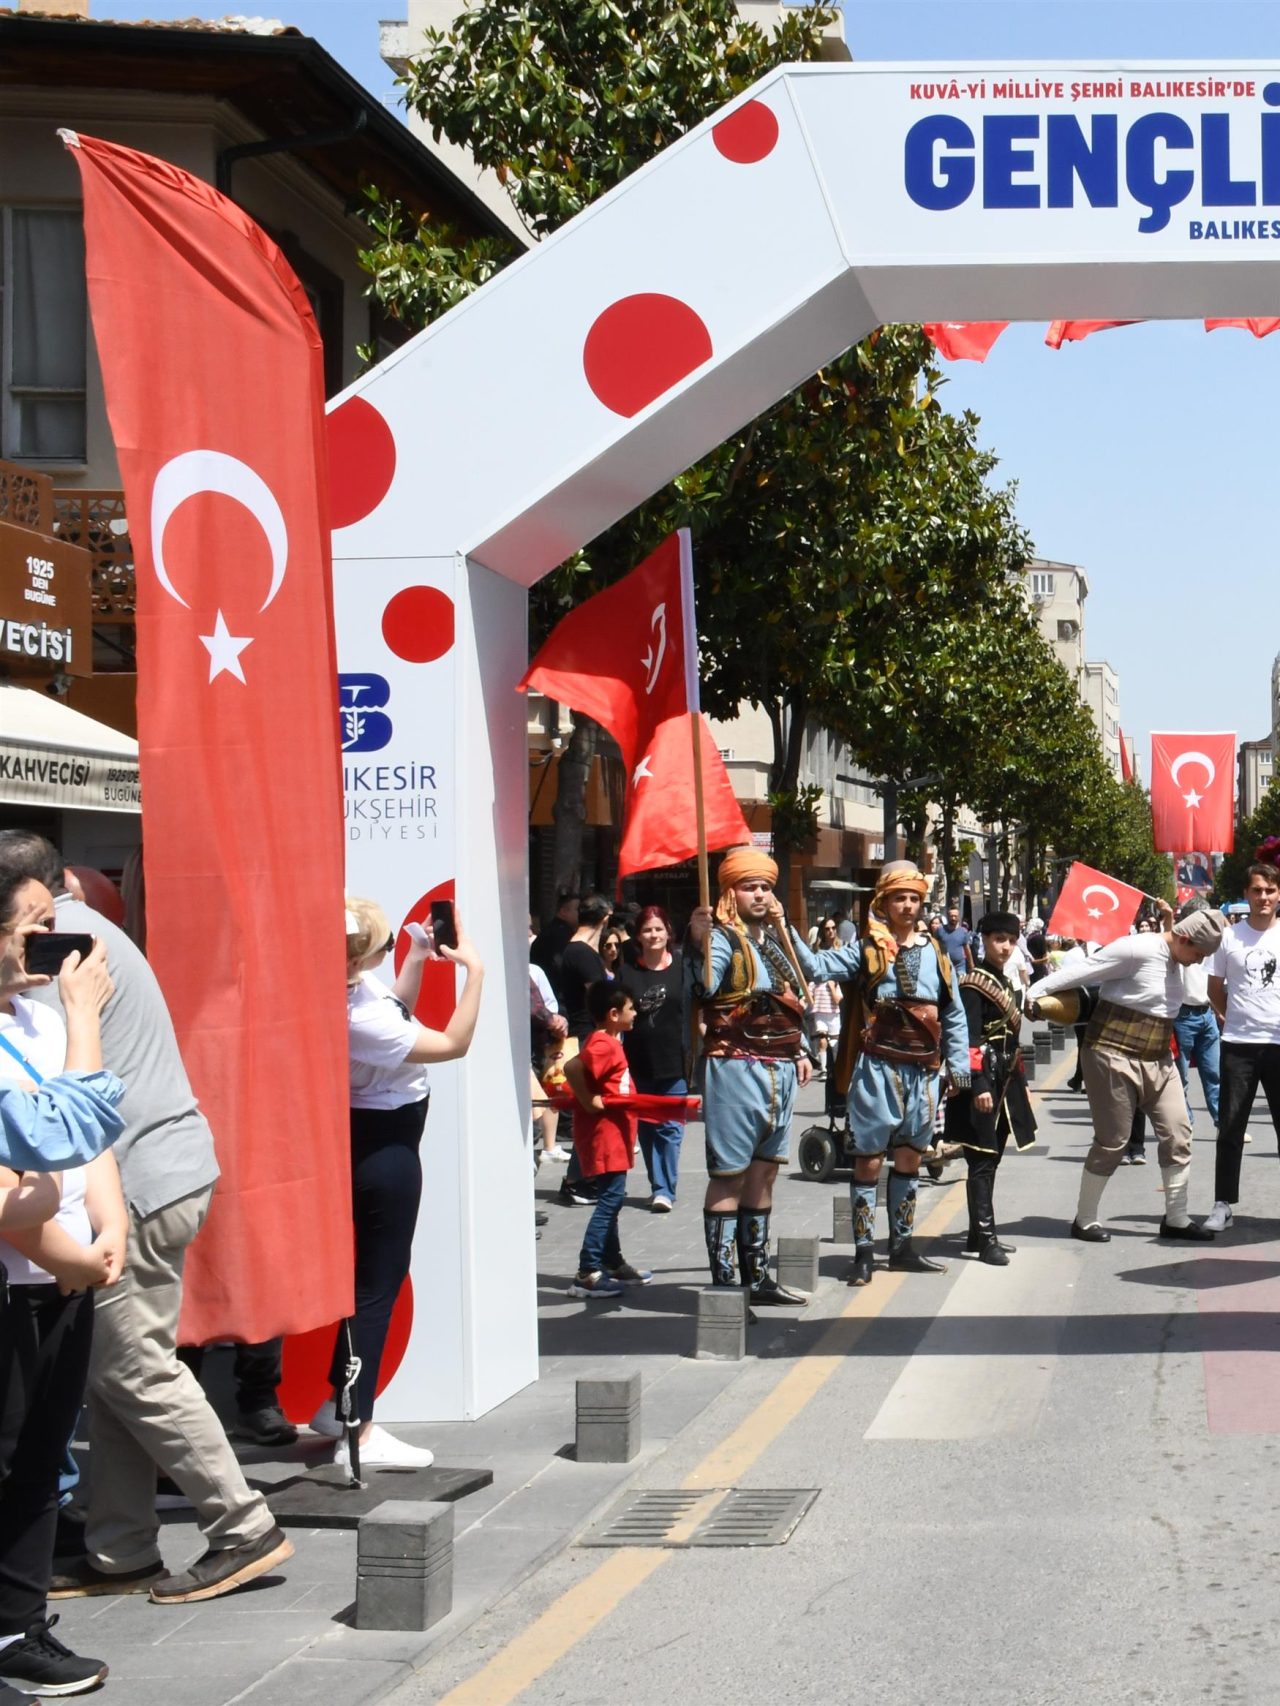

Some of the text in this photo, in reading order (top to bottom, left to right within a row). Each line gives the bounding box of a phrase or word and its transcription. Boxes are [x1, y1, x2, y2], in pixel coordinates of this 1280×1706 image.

[910, 79, 986, 99] KUVÂ-Yİ
[993, 78, 1064, 98] MİLLİYE
[1070, 77, 1123, 102] ŞEHRİ
[26, 556, 55, 579] 1925
[24, 588, 56, 606] BUGÜNE
[0, 754, 91, 787] KAHVECİSİ
